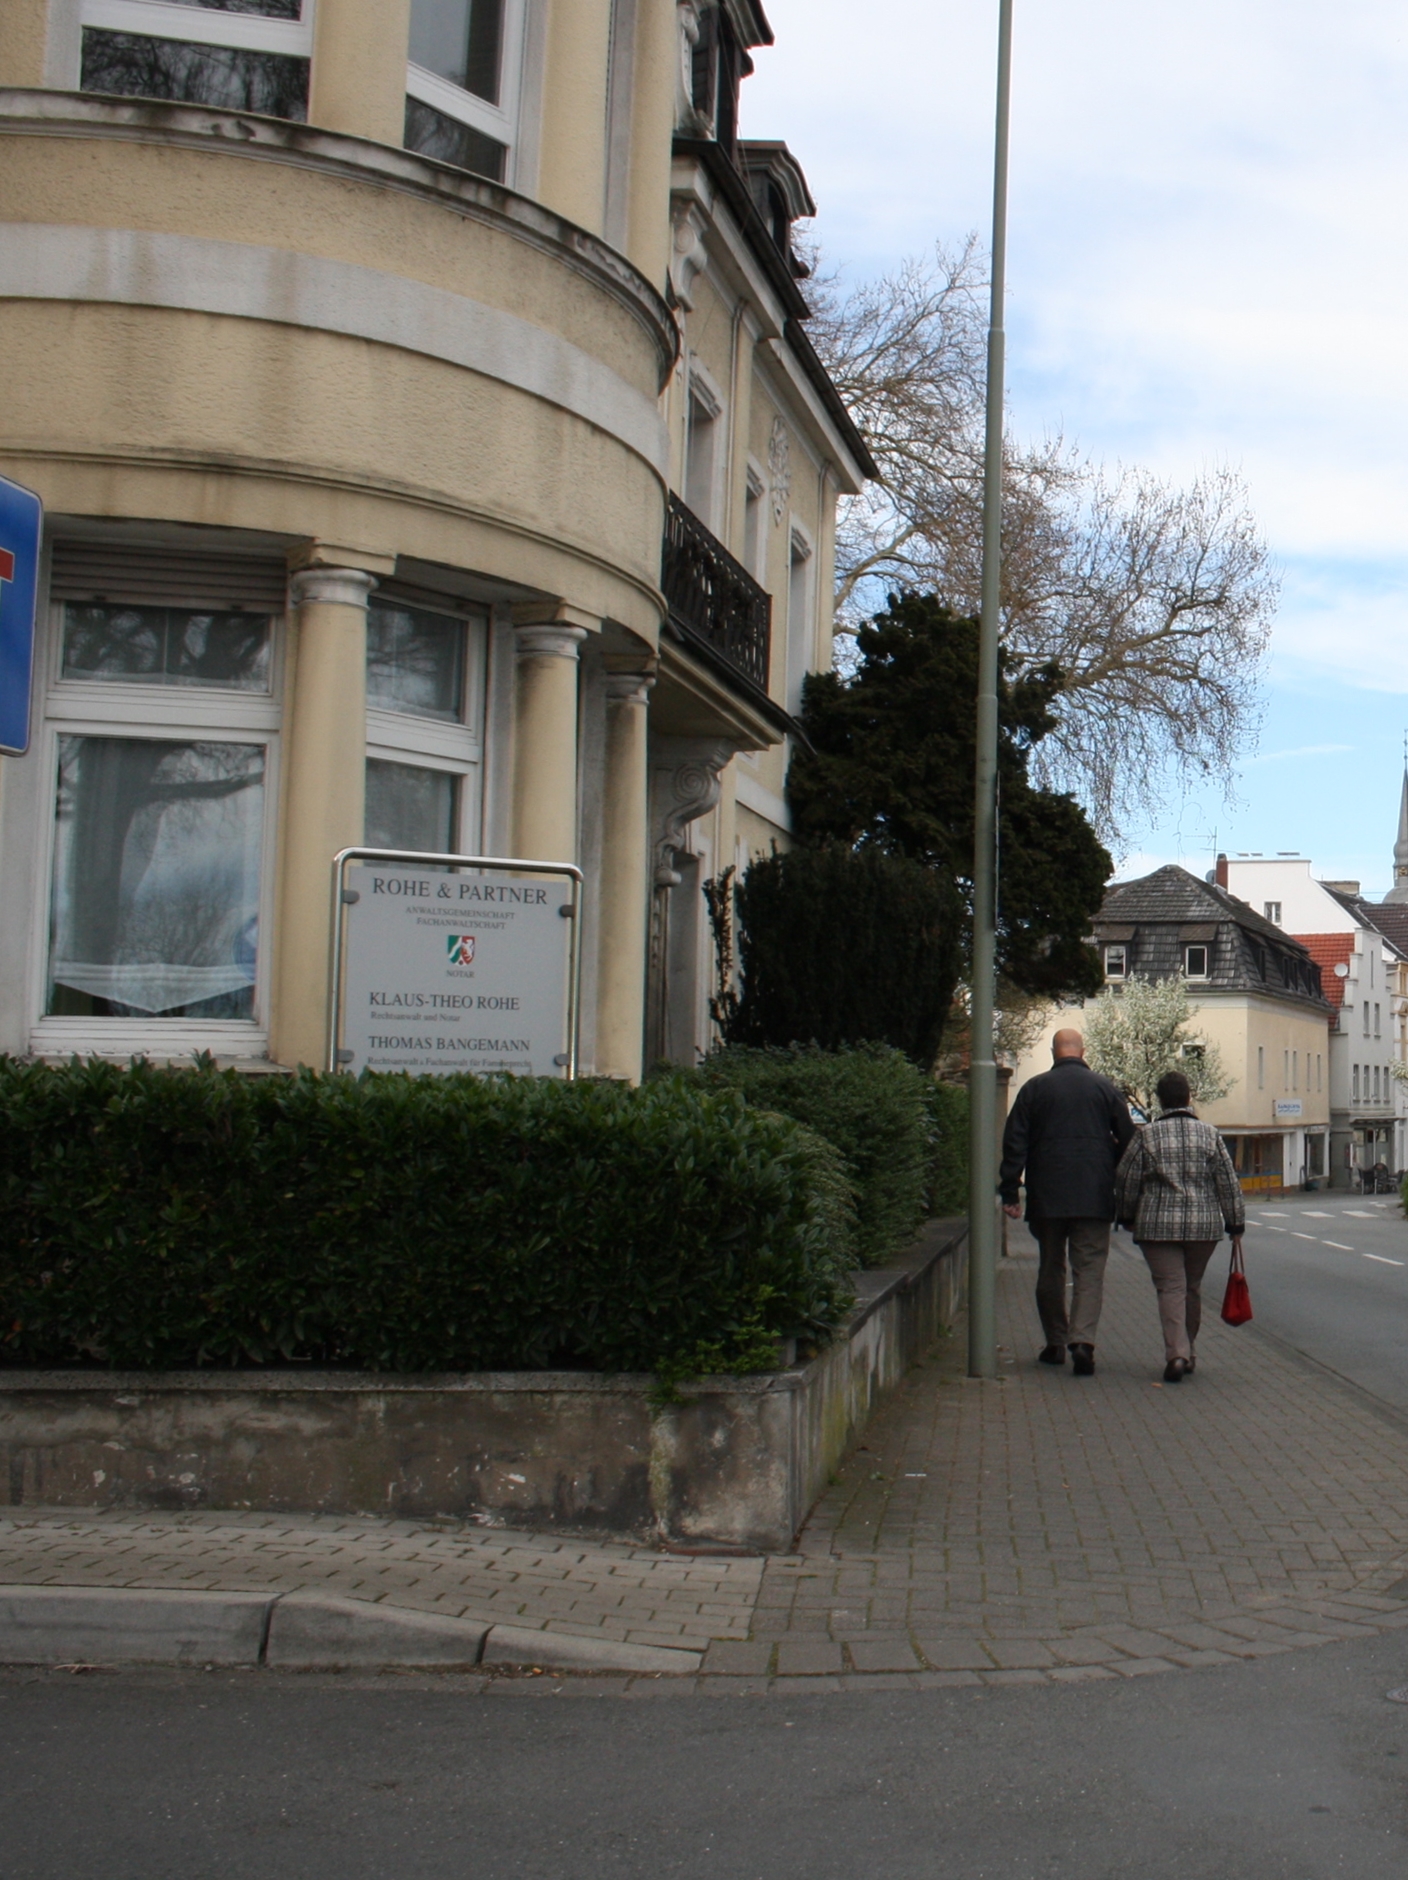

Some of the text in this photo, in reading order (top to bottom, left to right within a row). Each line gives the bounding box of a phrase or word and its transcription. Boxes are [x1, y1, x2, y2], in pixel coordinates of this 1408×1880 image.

[373, 878, 548, 905] ROHE & PARTNER
[406, 906, 514, 919] ANWALTSGEMEINSCHAFT
[416, 917, 506, 930] FACHANWALTSCHAFT
[446, 970, 475, 979] NOTAR
[370, 992, 520, 1011] KLAUS-THEO ROHE
[371, 1011, 422, 1021] Rechtsanwalt
[441, 1014, 461, 1022] Notar
[368, 1036, 530, 1051] THOMAS BANGEMANN
[368, 1057, 419, 1065] Rechtsanwalt
